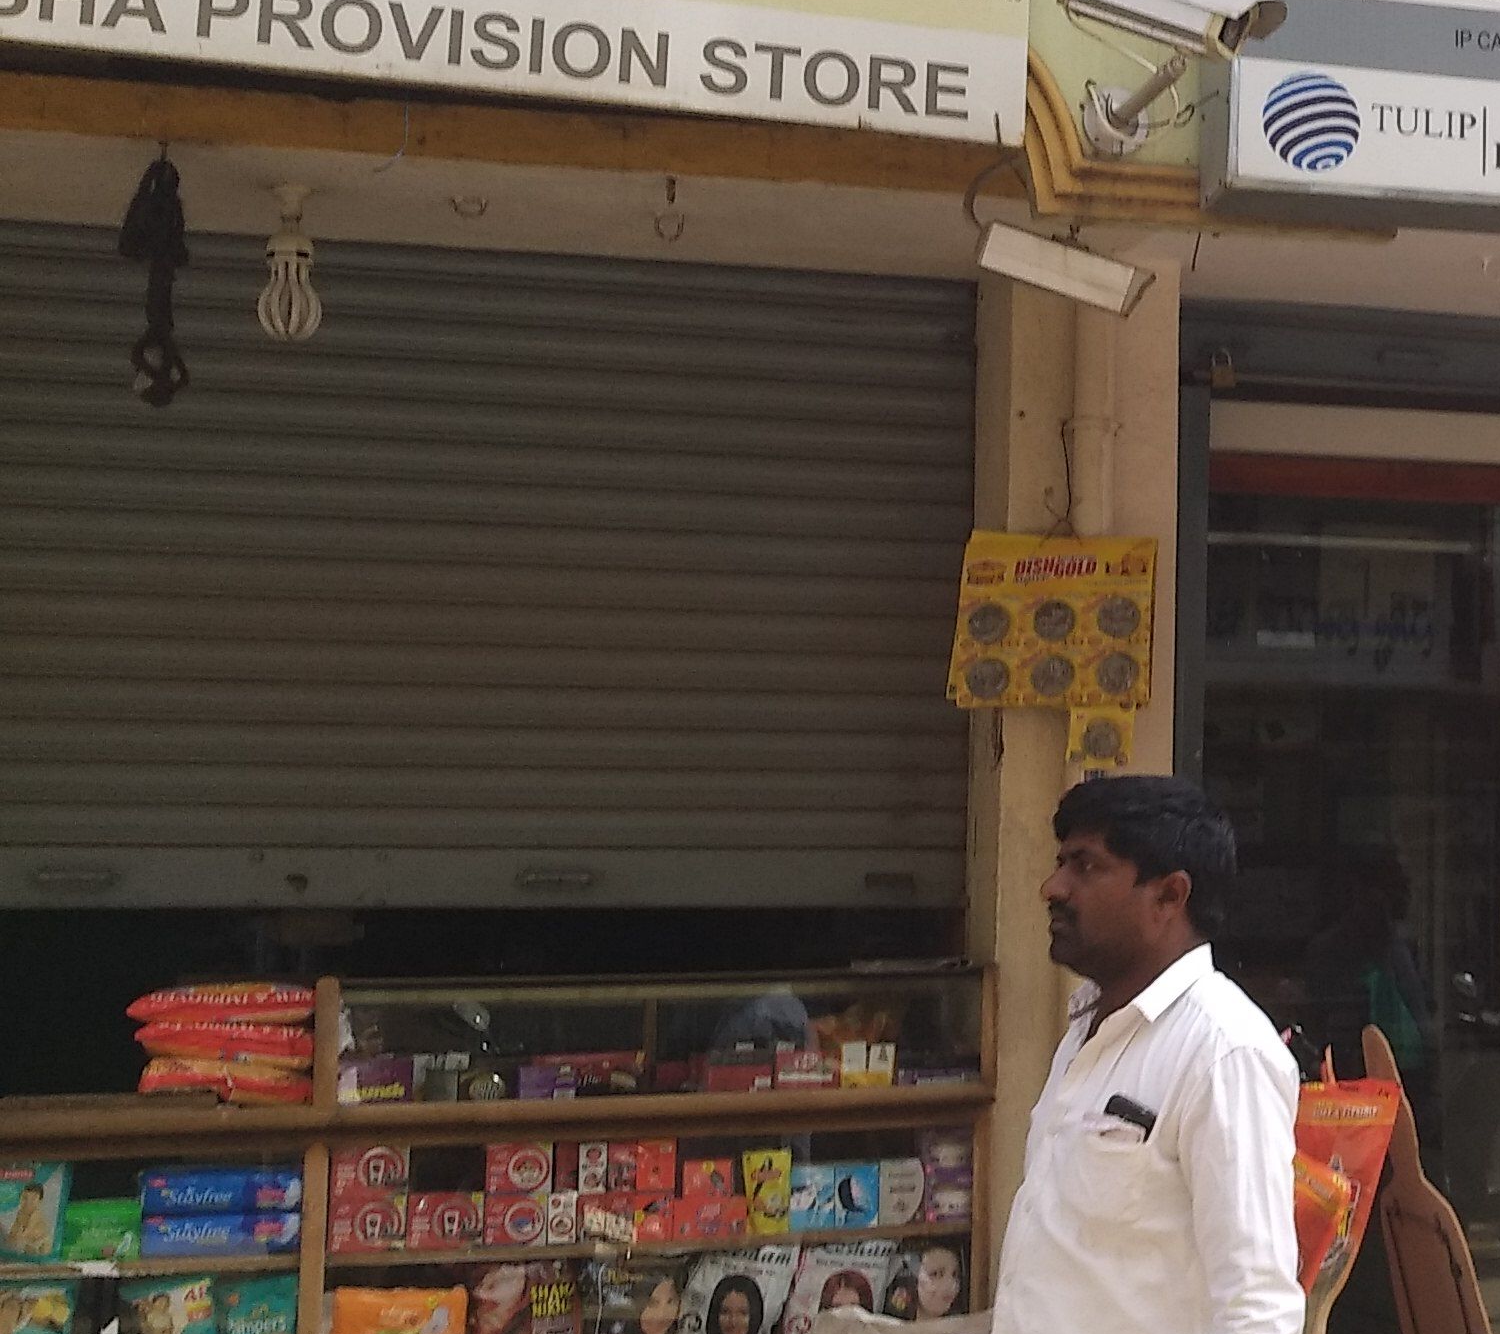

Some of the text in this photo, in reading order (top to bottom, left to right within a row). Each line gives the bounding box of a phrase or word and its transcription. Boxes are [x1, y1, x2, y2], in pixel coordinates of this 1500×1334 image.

[1454, 28, 1472, 50] IP
[699, 36, 970, 120] STORE
[1371, 102, 1477, 142] TULIP
